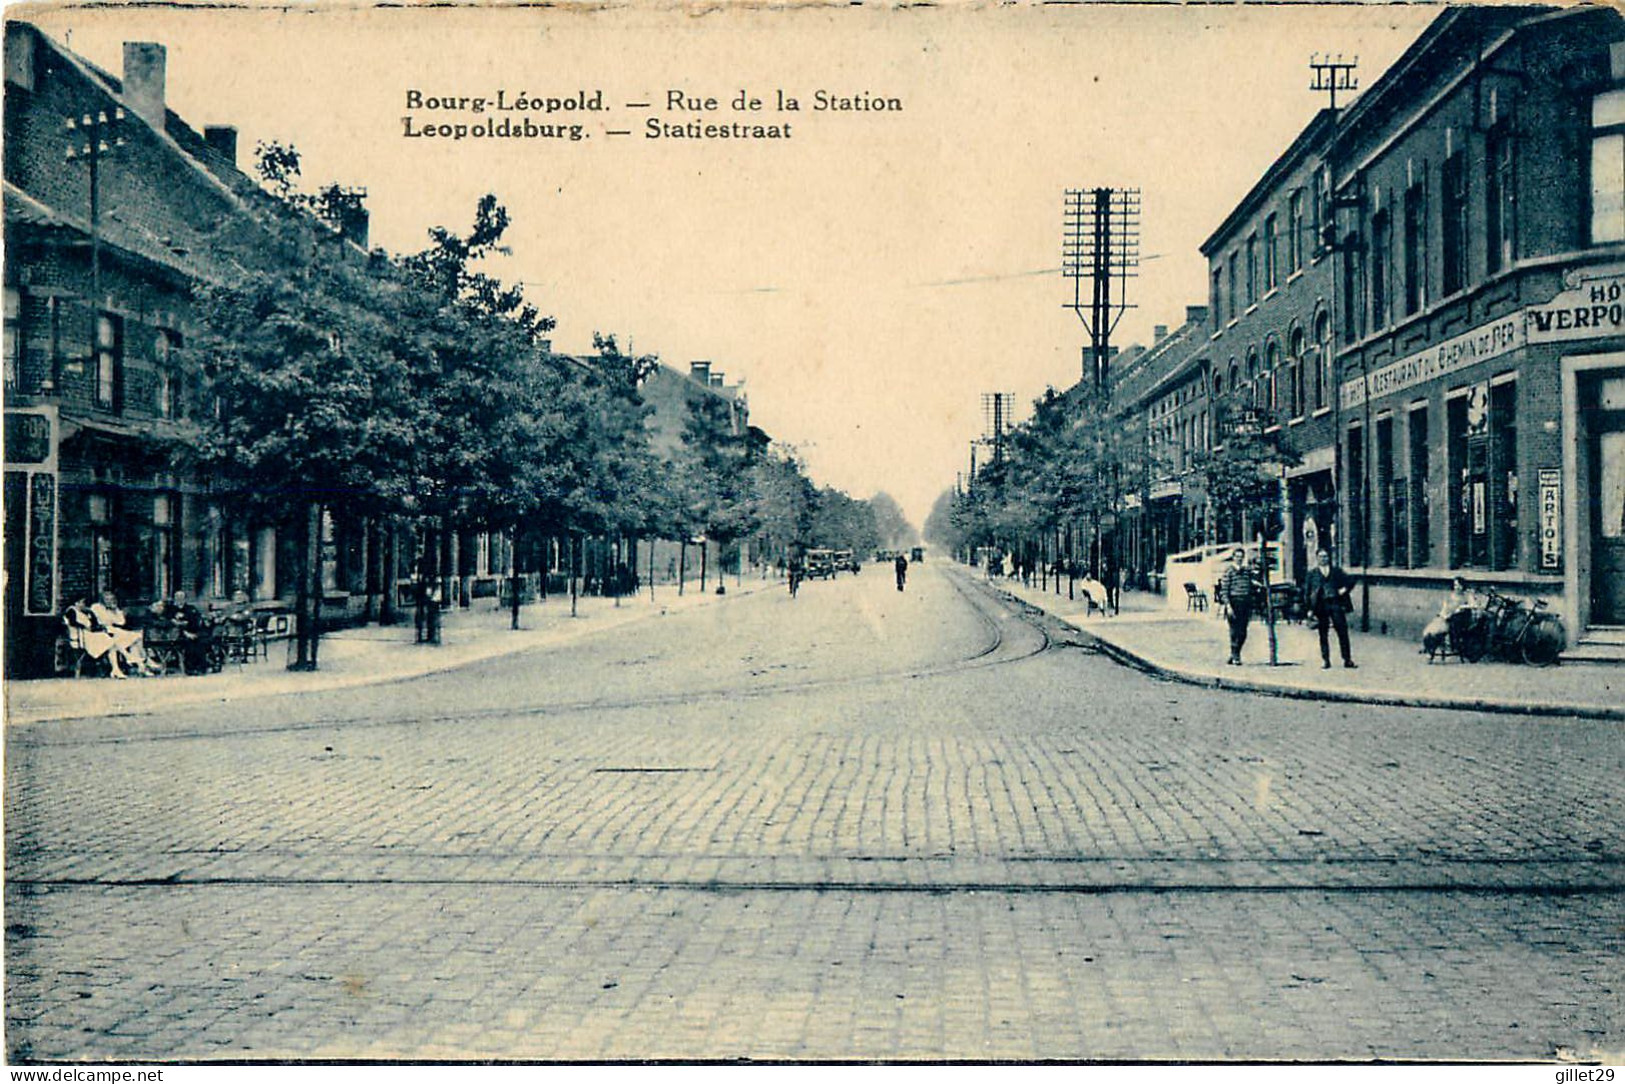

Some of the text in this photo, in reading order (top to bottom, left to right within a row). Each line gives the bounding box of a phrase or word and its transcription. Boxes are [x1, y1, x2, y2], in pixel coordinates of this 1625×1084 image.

[1531, 303, 1625, 332] VERPO
[1373, 357, 1423, 391] RESTAURANT
[1544, 490, 1556, 565] ARTOIS
